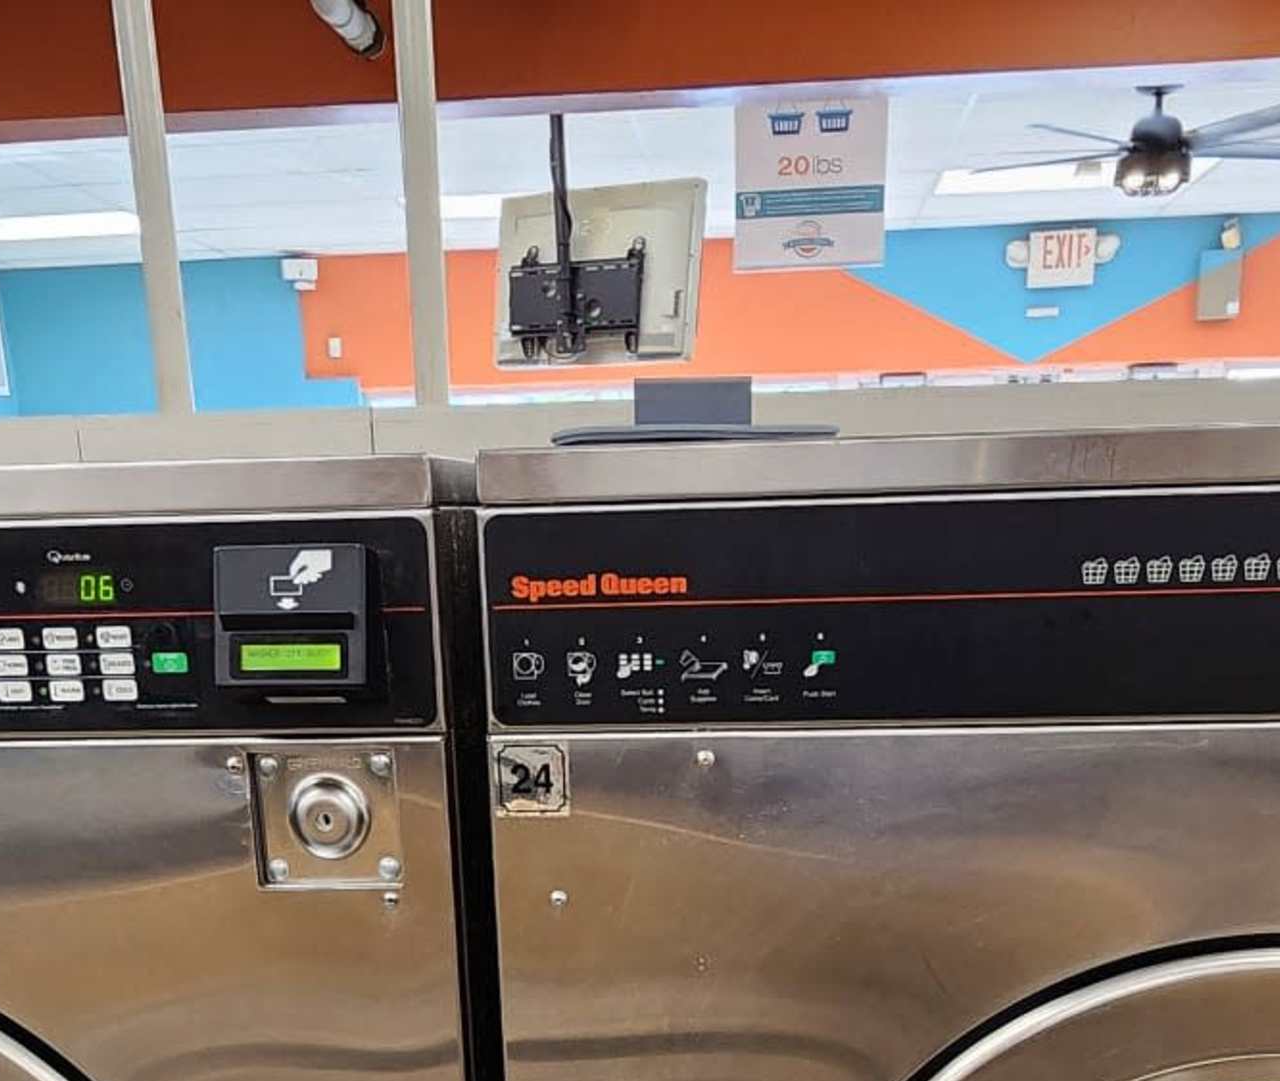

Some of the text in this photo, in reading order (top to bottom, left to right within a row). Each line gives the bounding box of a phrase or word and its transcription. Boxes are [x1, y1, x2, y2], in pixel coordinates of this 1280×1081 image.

[1042, 233, 1087, 269] EXIT
[80, 574, 114, 602] 06
[511, 572, 688, 603] Speed Queen
[511, 763, 554, 794] 24
